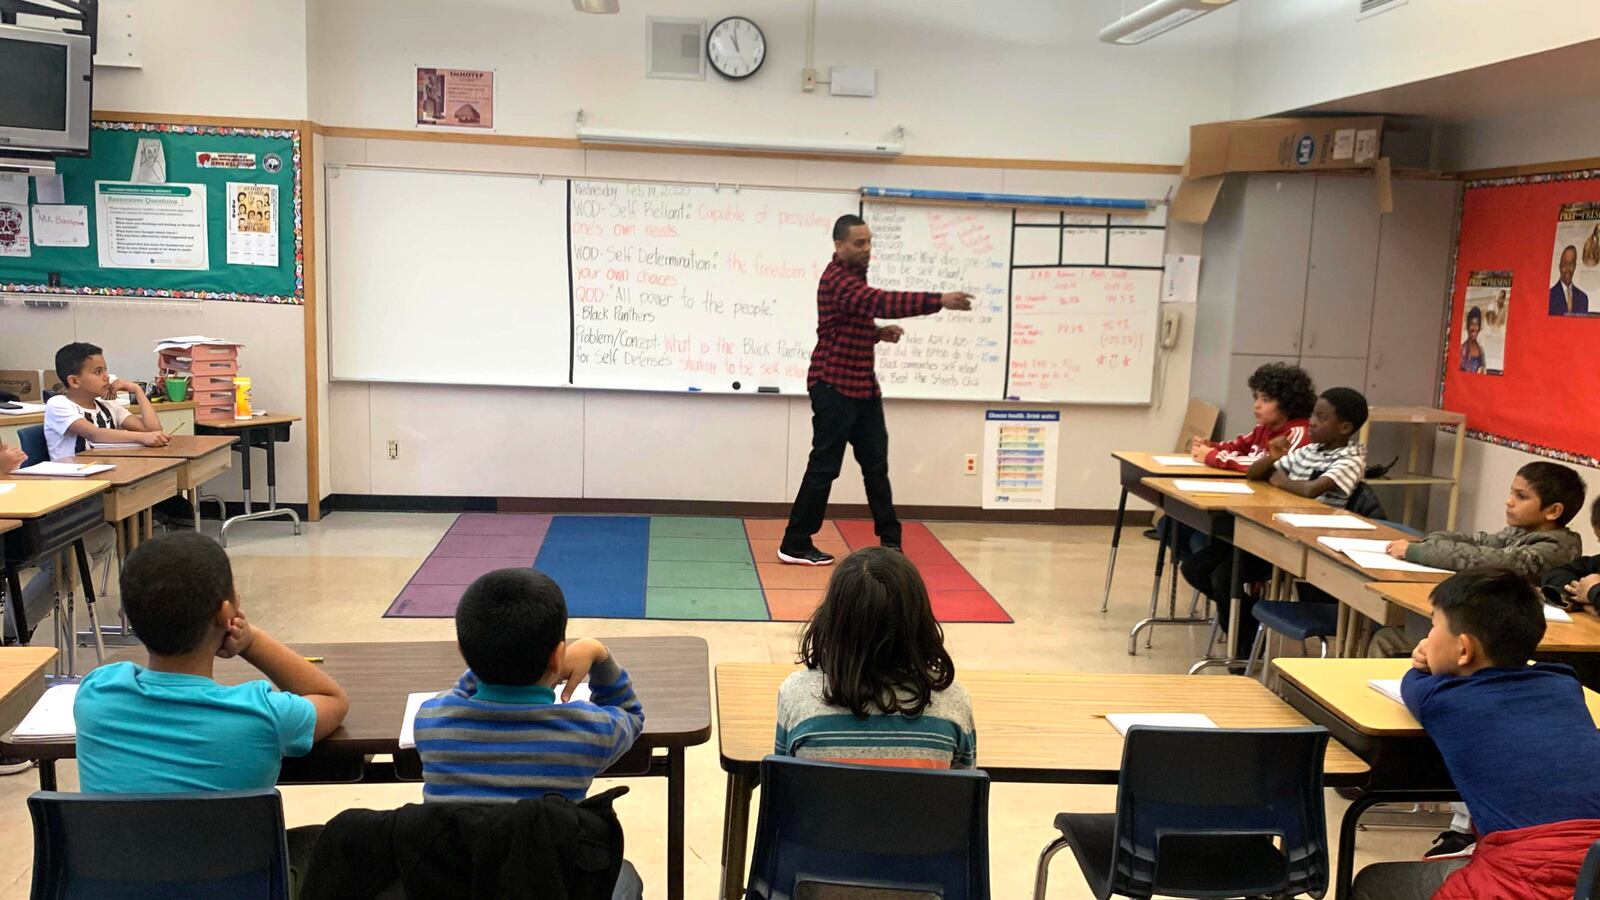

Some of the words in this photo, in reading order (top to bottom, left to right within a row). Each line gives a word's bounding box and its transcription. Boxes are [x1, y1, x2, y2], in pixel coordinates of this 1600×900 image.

[574, 181, 617, 200] Wednesday
[145, 196, 178, 205] Questions
[614, 223, 636, 236] own
[726, 251, 748, 273] the
[606, 268, 629, 282] own
[1486, 278, 1511, 287] PRESENT
[640, 291, 674, 308] power
[680, 286, 695, 309] to
[702, 288, 725, 314] the
[614, 304, 656, 322] Panthers
[664, 333, 691, 353] What
[716, 335, 735, 355] the
[576, 345, 589, 363] for
[594, 347, 619, 366] Self
[740, 358, 753, 376] be
